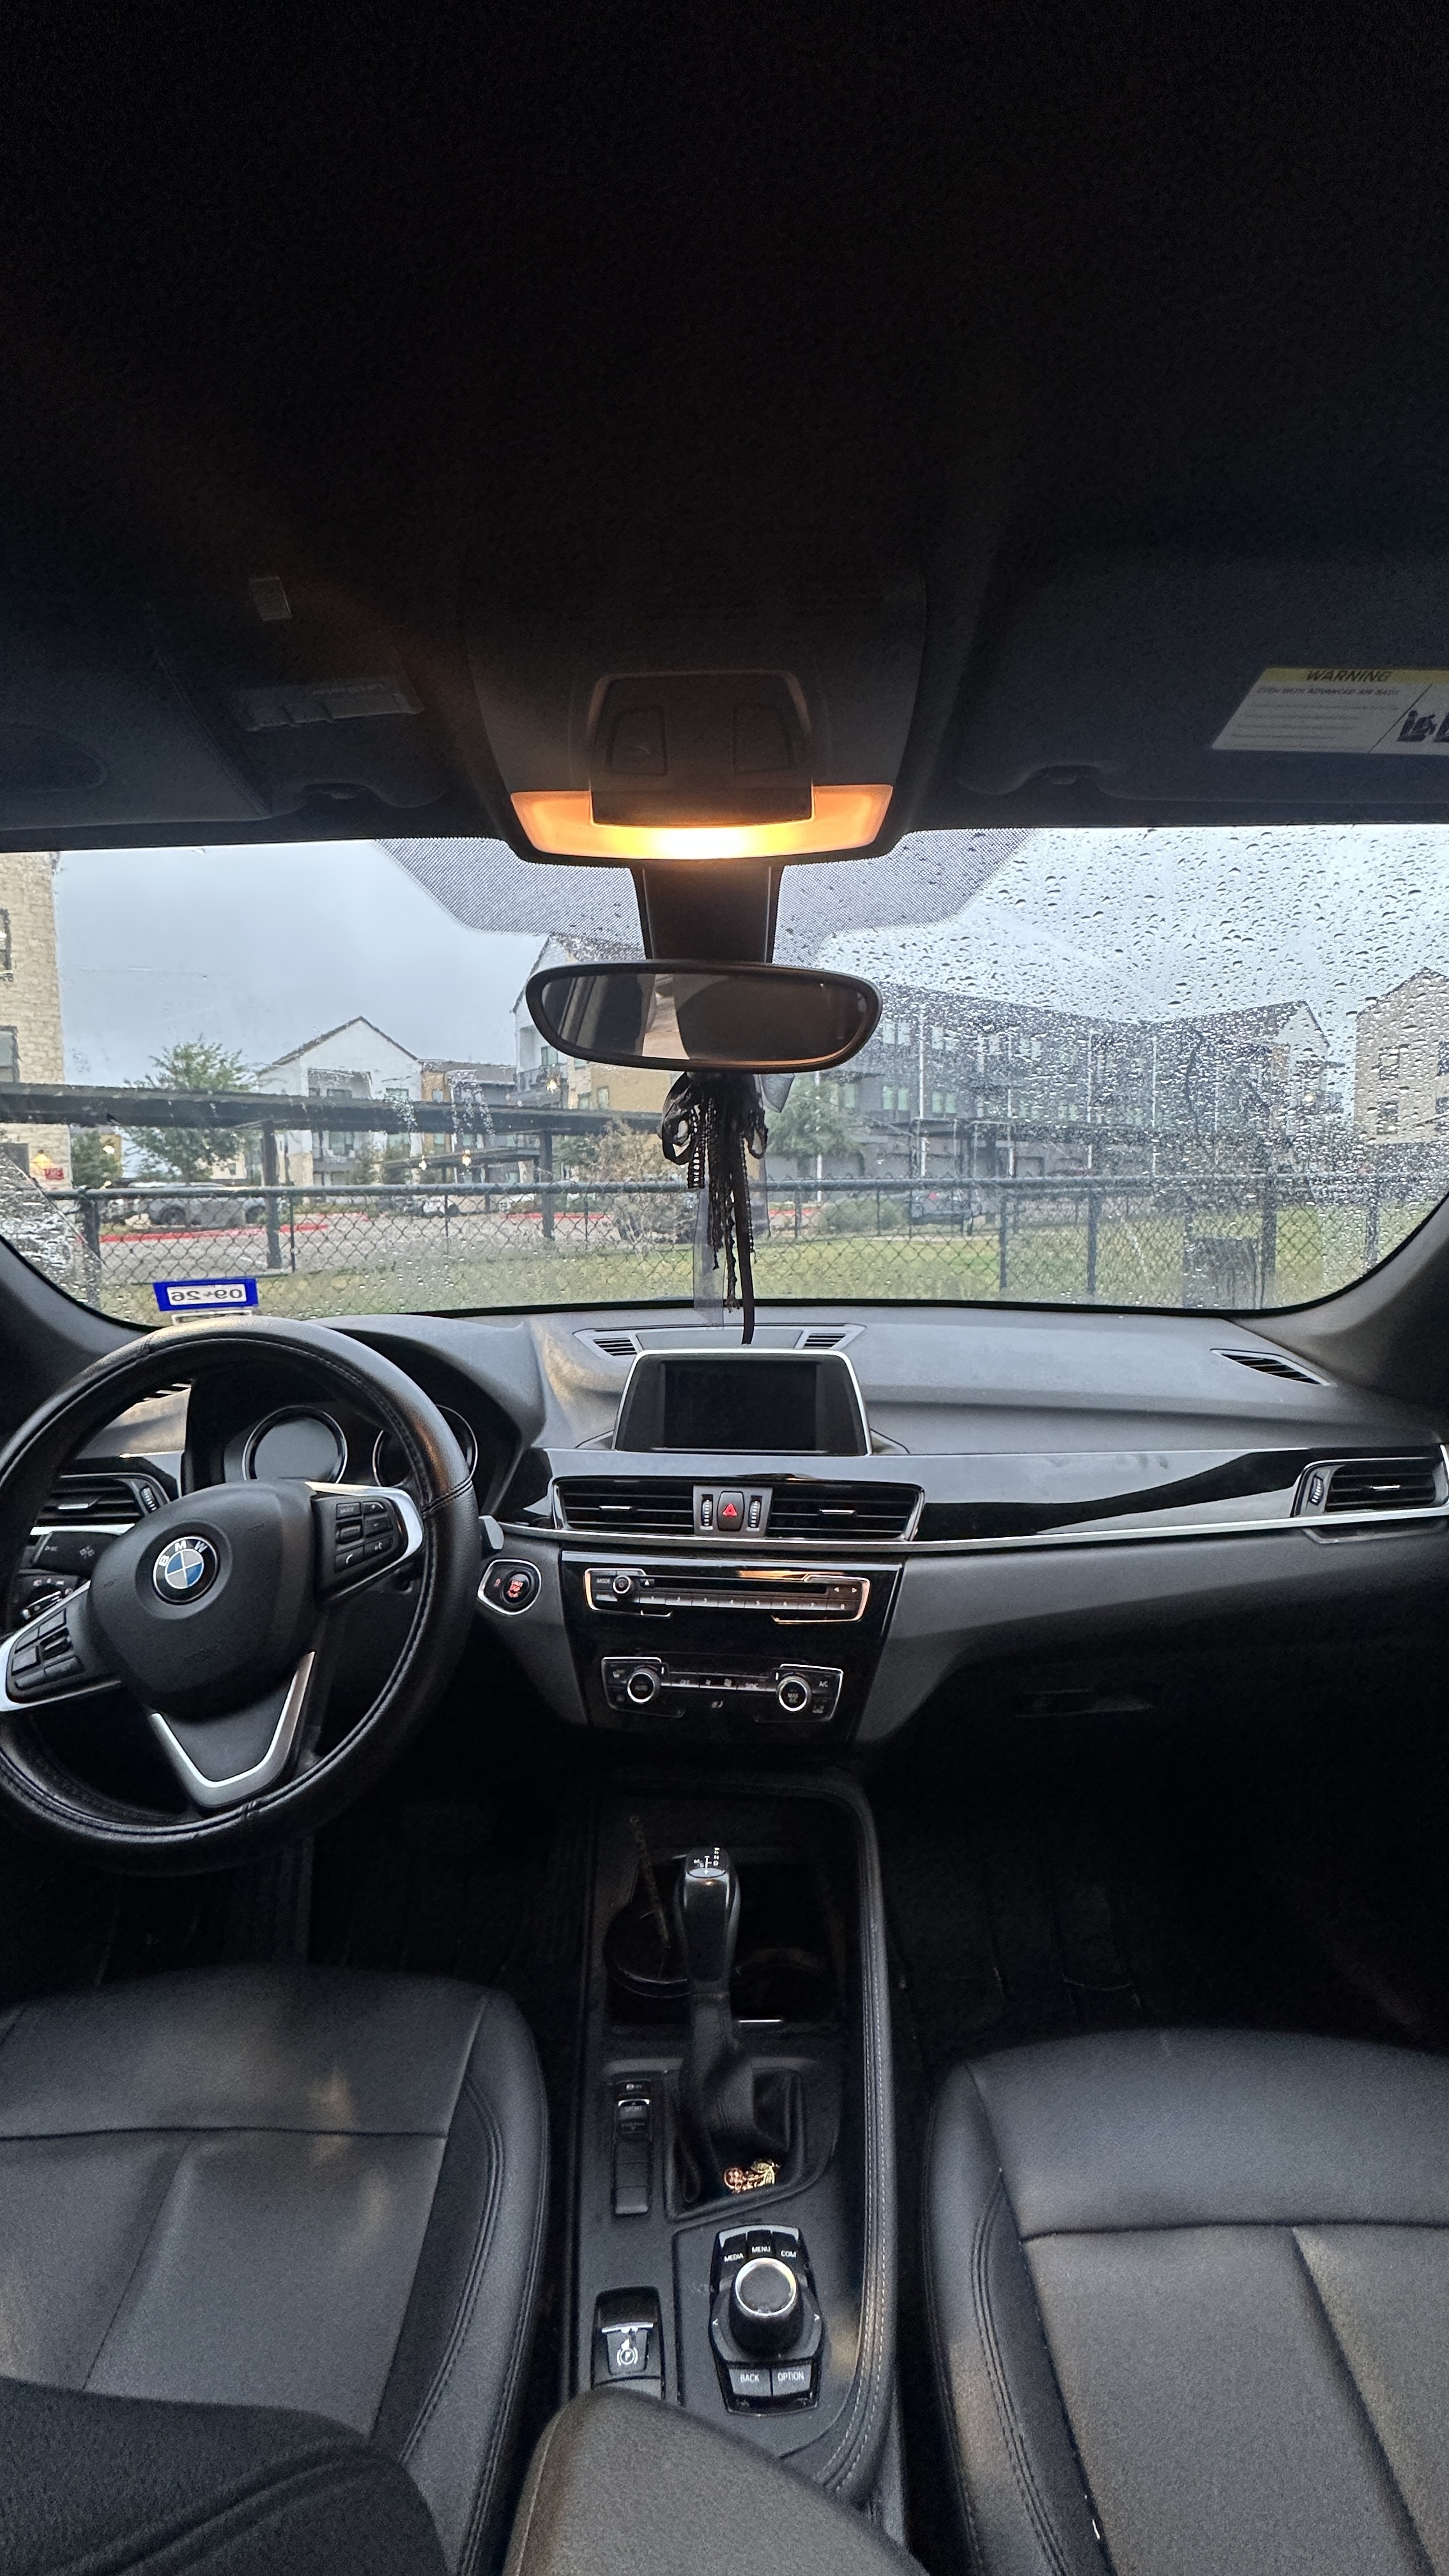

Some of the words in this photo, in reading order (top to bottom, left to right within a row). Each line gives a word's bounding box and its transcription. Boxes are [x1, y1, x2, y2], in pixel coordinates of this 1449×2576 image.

[1306, 670, 1392, 682] WARNING
[158, 1540, 208, 1567] BMW
[724, 2253, 744, 2262] MEDIA
[780, 2250, 797, 2258] COM
[739, 2373, 760, 2383] BACK
[777, 2370, 805, 2382] OPTION
